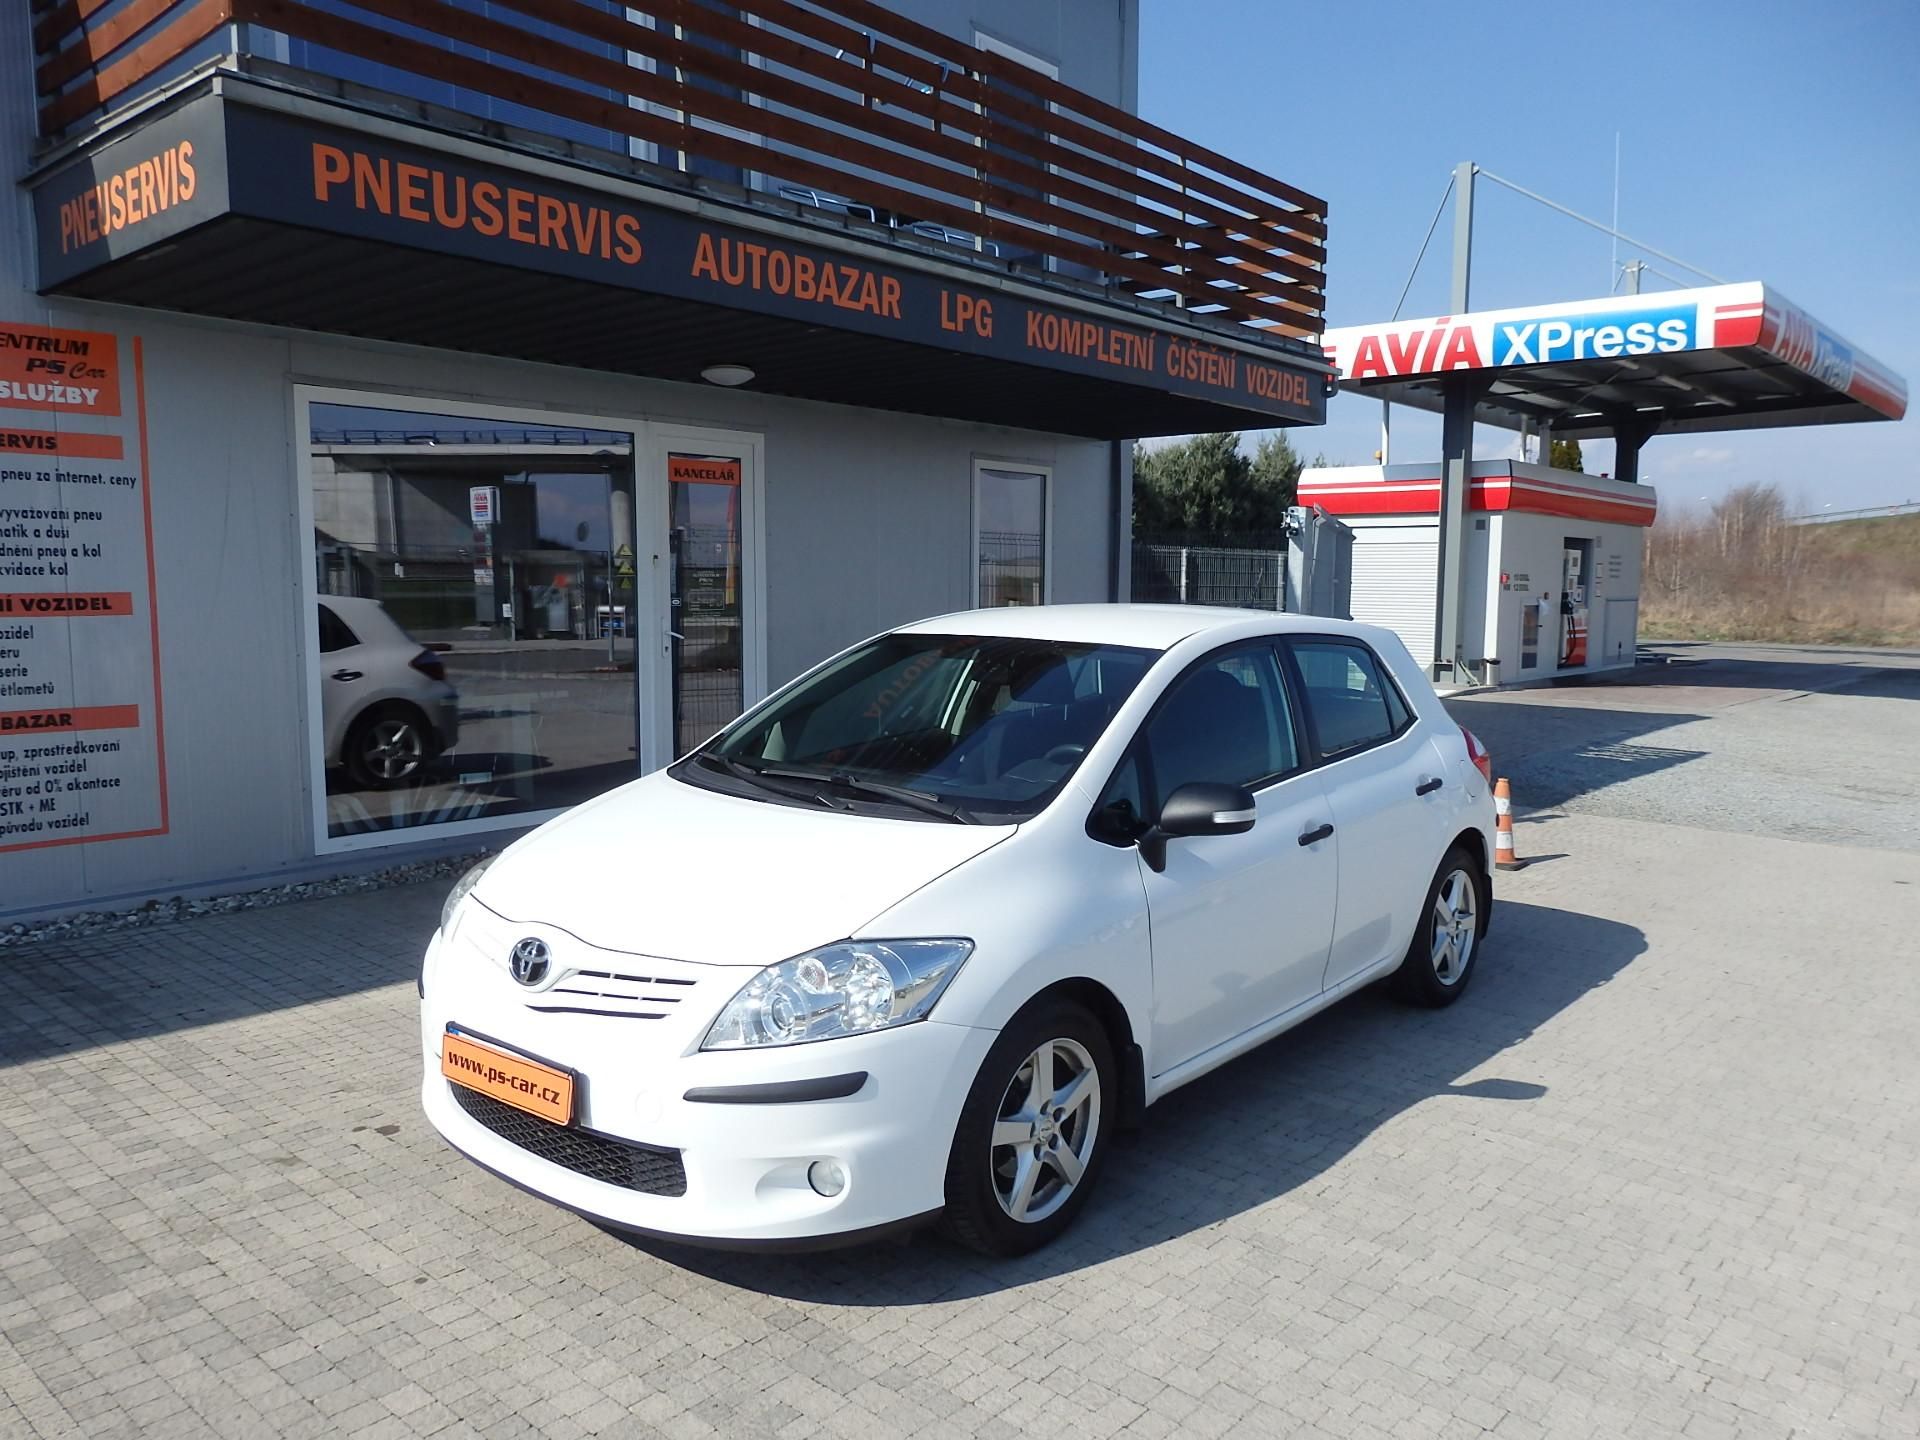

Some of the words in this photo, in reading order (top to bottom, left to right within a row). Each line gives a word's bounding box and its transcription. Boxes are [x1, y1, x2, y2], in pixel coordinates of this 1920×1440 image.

[60, 140, 196, 255] PNEUSERVIS
[312, 143, 642, 265] PNEUSERVIS
[691, 232, 901, 319] AUTOBAZAR
[941, 289, 993, 338] LPG
[1026, 310, 1157, 371] KOMPLETNÍ
[1166, 334, 1237, 388] ČIŠTĚNÍ
[1246, 363, 1311, 406] VOZIDEL
[1501, 319, 1688, 366] XPress
[26, 358, 67, 375] PS
[0, 380, 99, 406] SLUŽBY
[2, 470, 31, 483] pneu
[36, 472, 50, 481] za
[56, 468, 106, 484] internet.
[110, 476, 137, 489] ceny
[74, 511, 102, 523] pneu
[34, 529, 41, 538] a
[37, 547, 66, 560] pneu
[71, 549, 78, 557] a
[83, 544, 101, 558] kol
[49, 562, 68, 576] kol
[20, 597, 112, 611] VOZIDEL
[45, 758, 87, 775] vozidel
[26, 781, 40, 795] od
[45, 779, 62, 793] 0%
[67, 777, 121, 791] akontace
[0, 801, 24, 817] STK
[48, 812, 89, 829] vozidel
[448, 1051, 561, 1106] www.ps-car.cz
